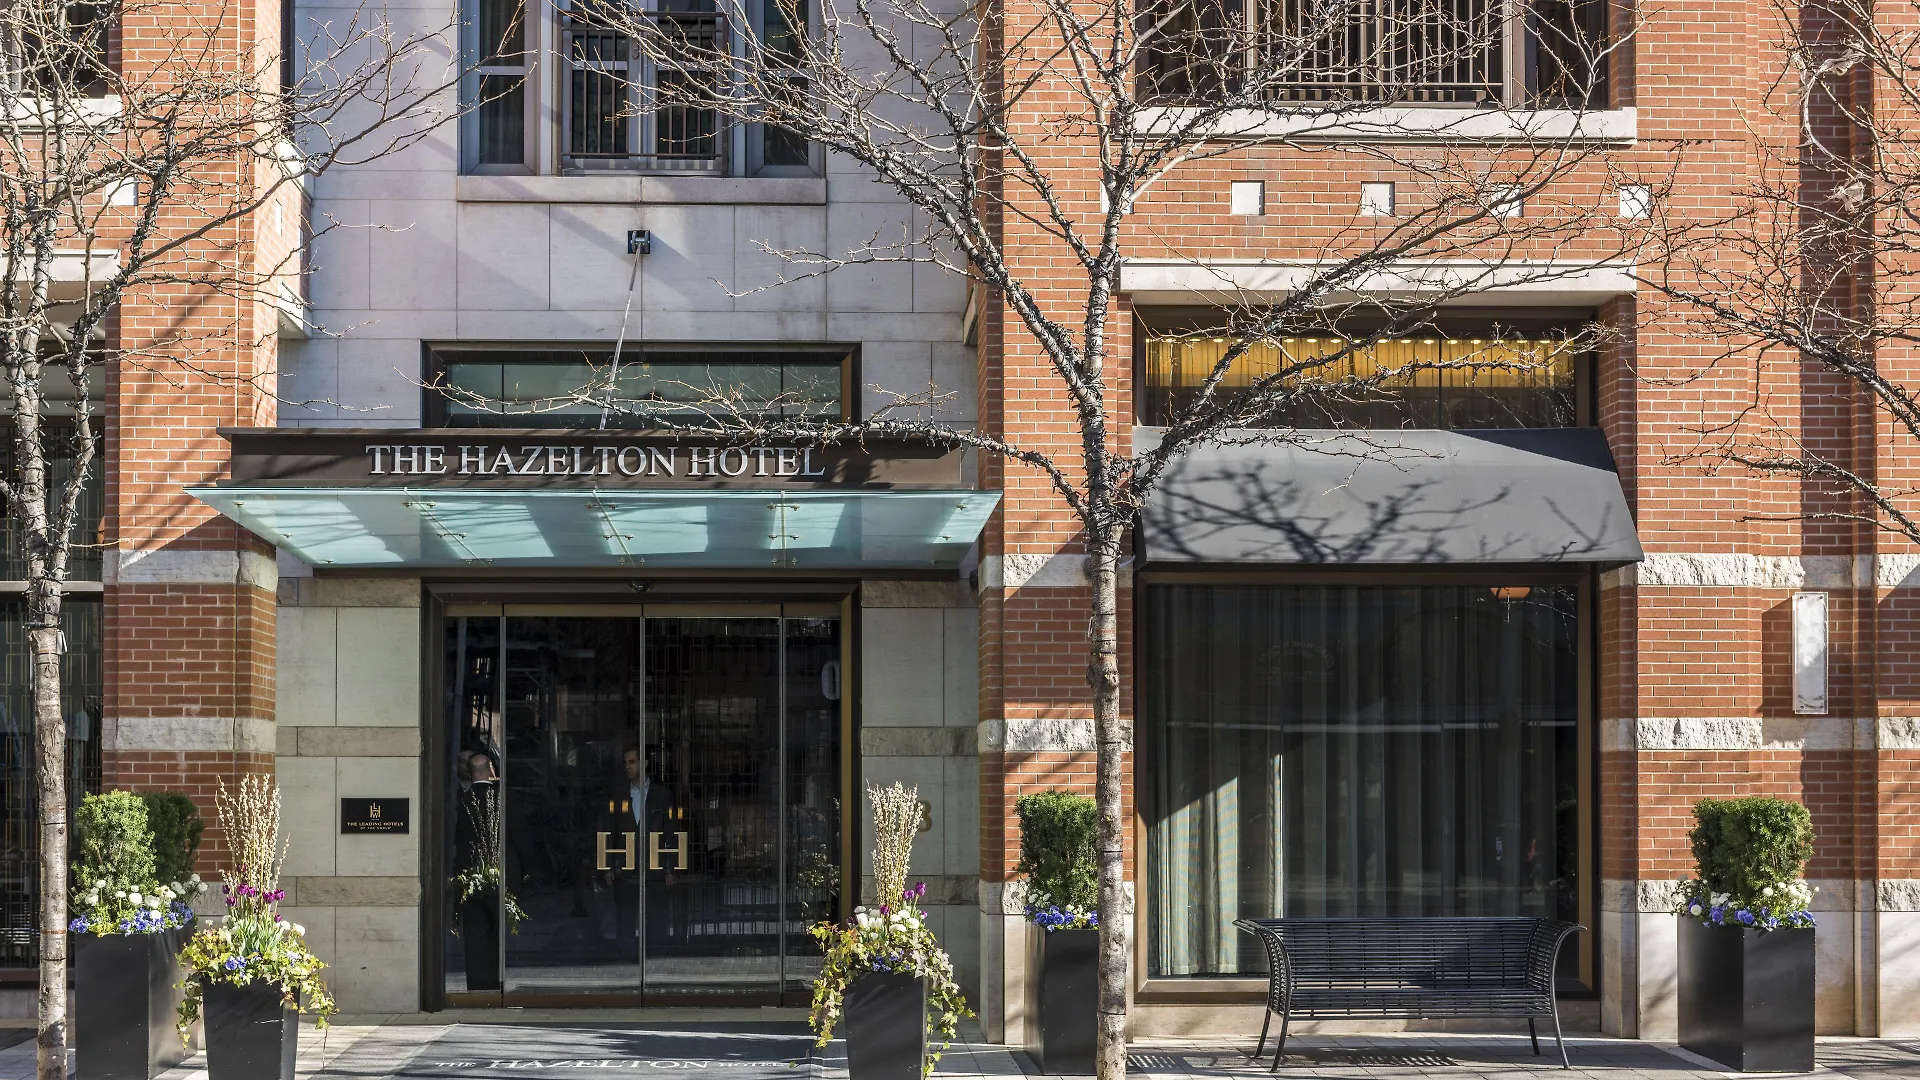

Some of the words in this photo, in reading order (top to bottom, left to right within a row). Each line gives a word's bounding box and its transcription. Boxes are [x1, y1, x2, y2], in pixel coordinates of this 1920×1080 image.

[366, 445, 447, 475] THE
[458, 445, 677, 476] HAZELTON
[688, 446, 825, 476] HOTEL
[485, 1060, 711, 1069] HAZELTON
